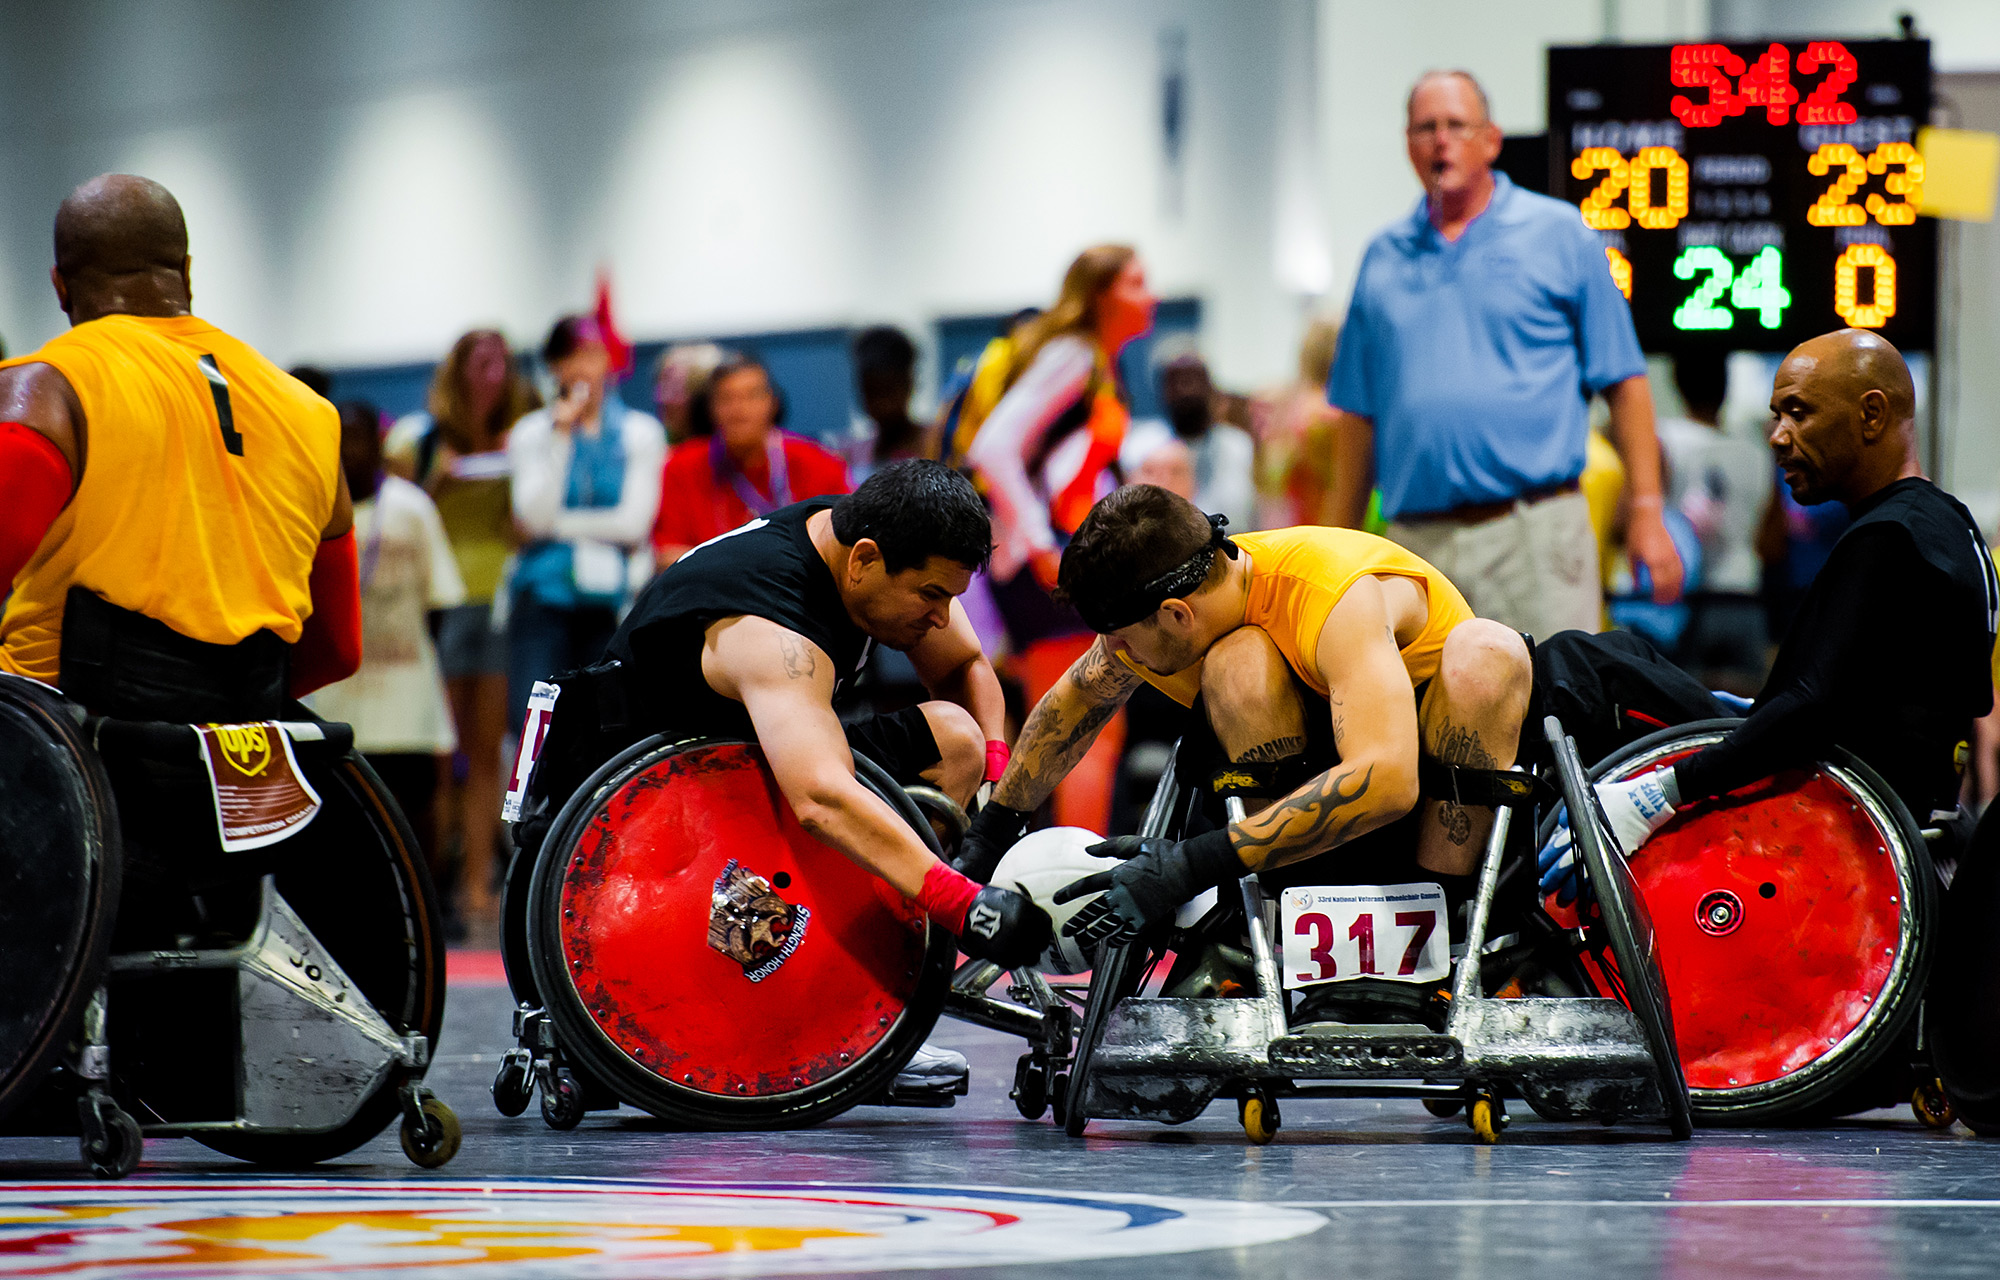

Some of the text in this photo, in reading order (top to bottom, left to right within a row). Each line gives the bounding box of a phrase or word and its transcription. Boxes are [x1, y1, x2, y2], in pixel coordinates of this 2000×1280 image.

[1571, 147, 1689, 229] 20
[1807, 142, 1926, 226] 23
[1673, 245, 1791, 330] 24
[1835, 244, 1896, 328] 0
[221, 724, 266, 763] ups
[1628, 787, 1656, 819] FLEX
[1640, 782, 1667, 812] TUFF
[1385, 894, 1420, 902] Wheelchair
[781, 904, 811, 957] STRENGTH
[1294, 910, 1437, 982] 317
[745, 956, 784, 982] HONOR
